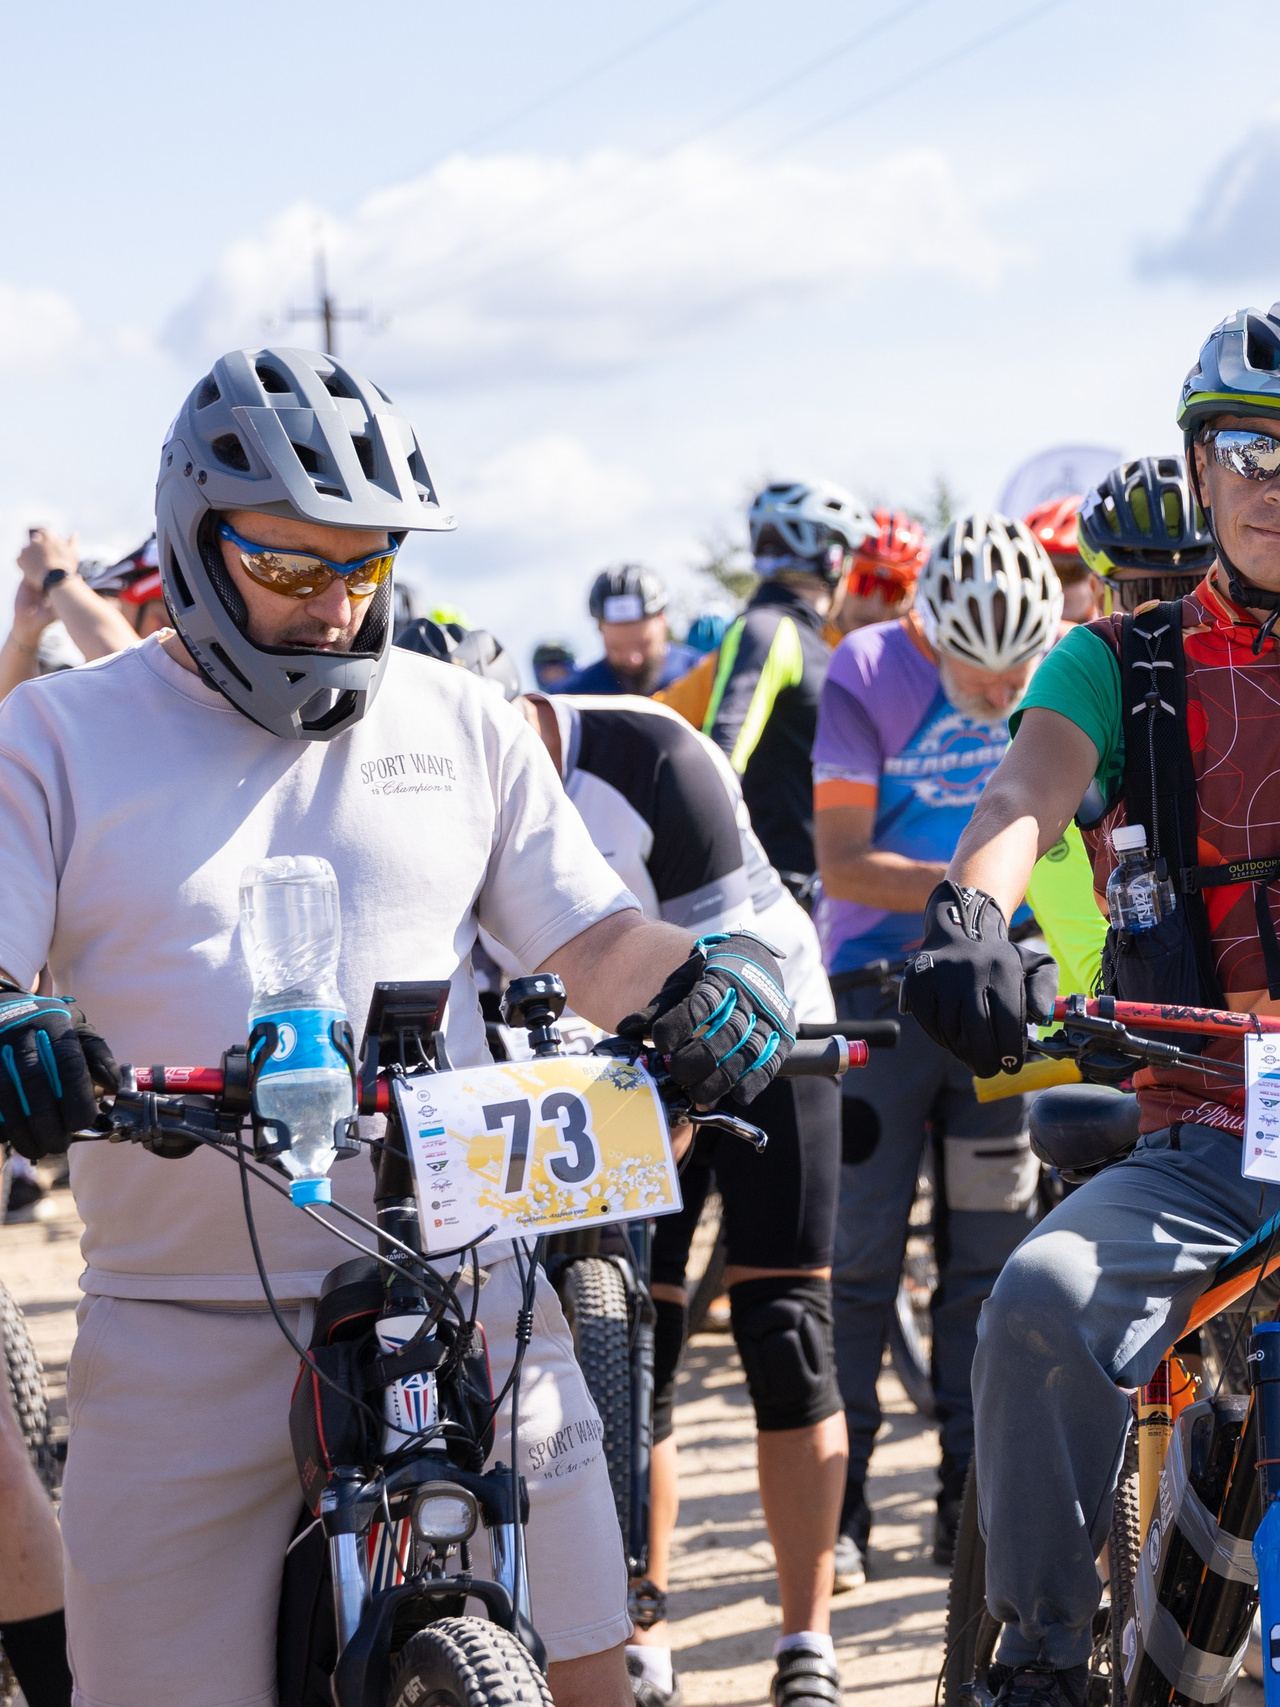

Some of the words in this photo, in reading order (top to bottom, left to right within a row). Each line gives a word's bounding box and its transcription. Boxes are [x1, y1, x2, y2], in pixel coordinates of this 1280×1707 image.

[360, 754, 406, 785] SPORT
[409, 753, 457, 781] WAVE
[374, 780, 443, 796] Champion
[481, 1092, 596, 1194] 73
[528, 1425, 575, 1471] SPORT
